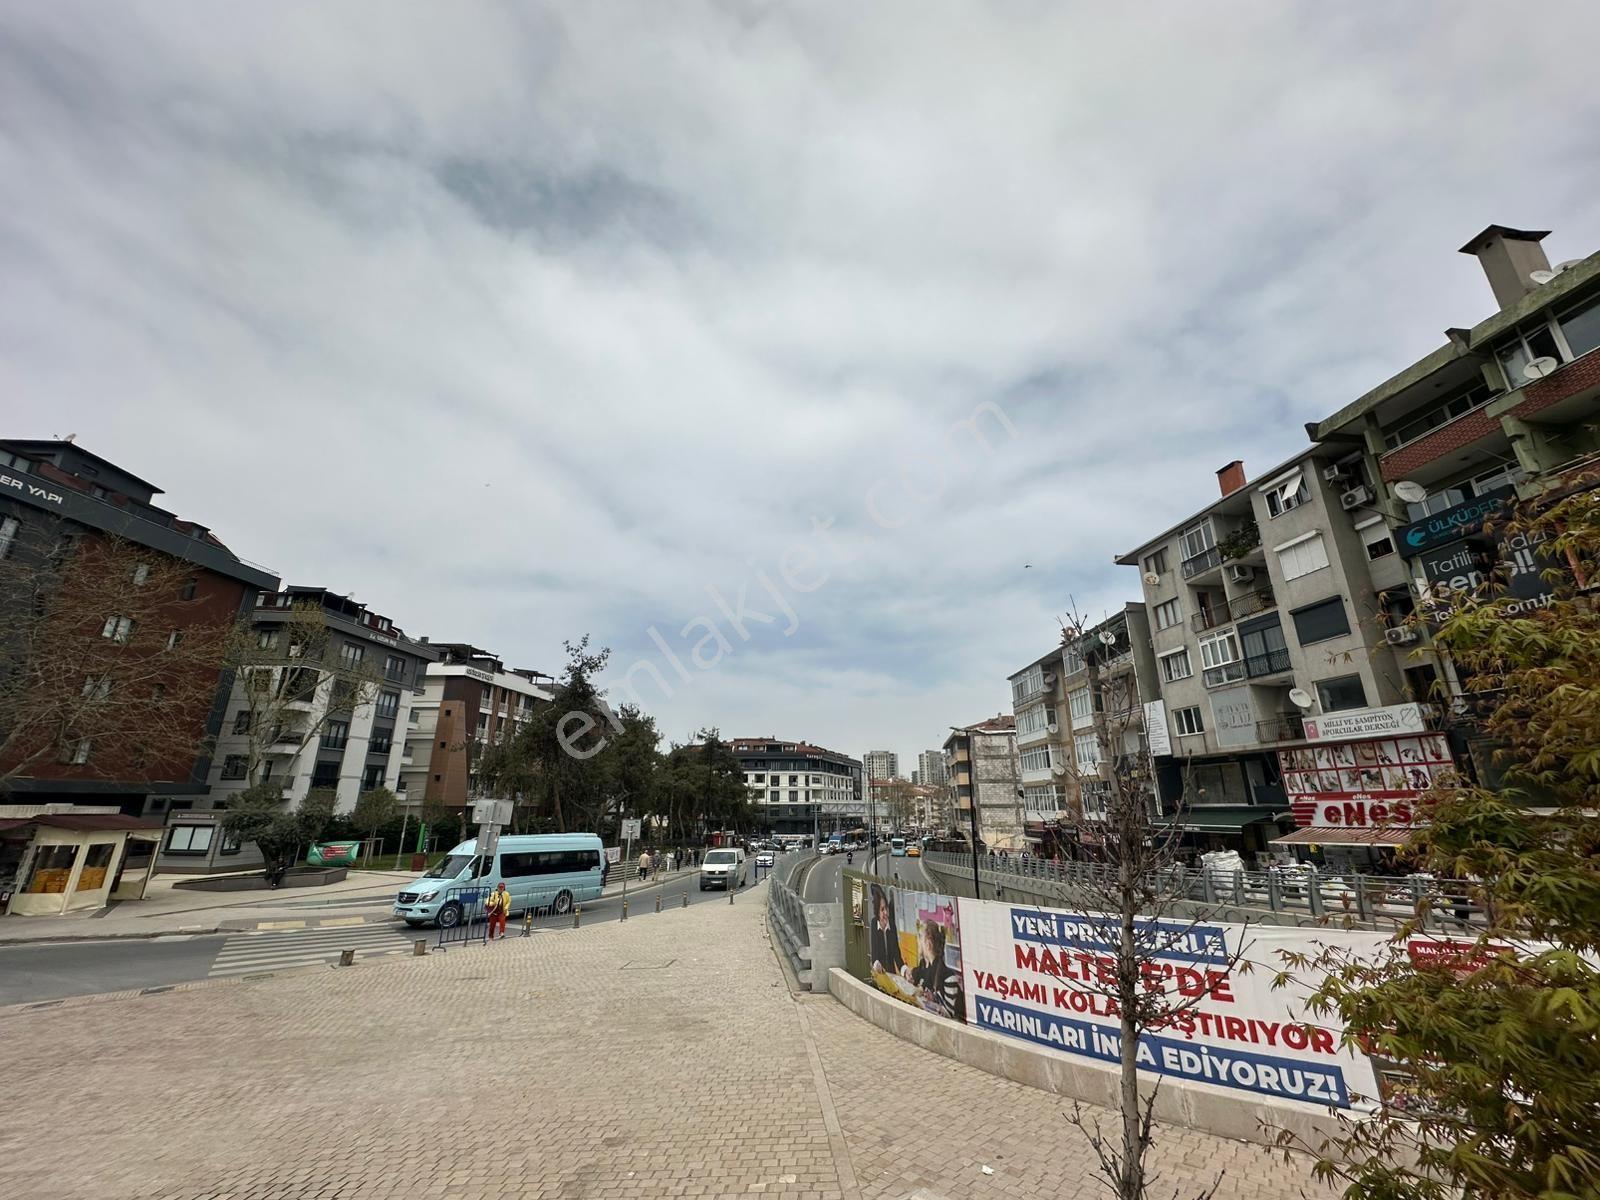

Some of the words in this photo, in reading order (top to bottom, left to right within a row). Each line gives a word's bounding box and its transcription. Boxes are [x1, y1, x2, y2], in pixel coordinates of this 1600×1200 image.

[28, 484, 63, 504] YAPI
[1012, 914, 1058, 939] YENİ
[973, 970, 1048, 1005] YAŞAMI
[1014, 944, 1235, 1003] MALTEE'DE
[978, 1003, 1086, 1050] YARINLARI
[1092, 1024, 1157, 1066] İNA
[1161, 1046, 1341, 1102] EDİYORUZ!
